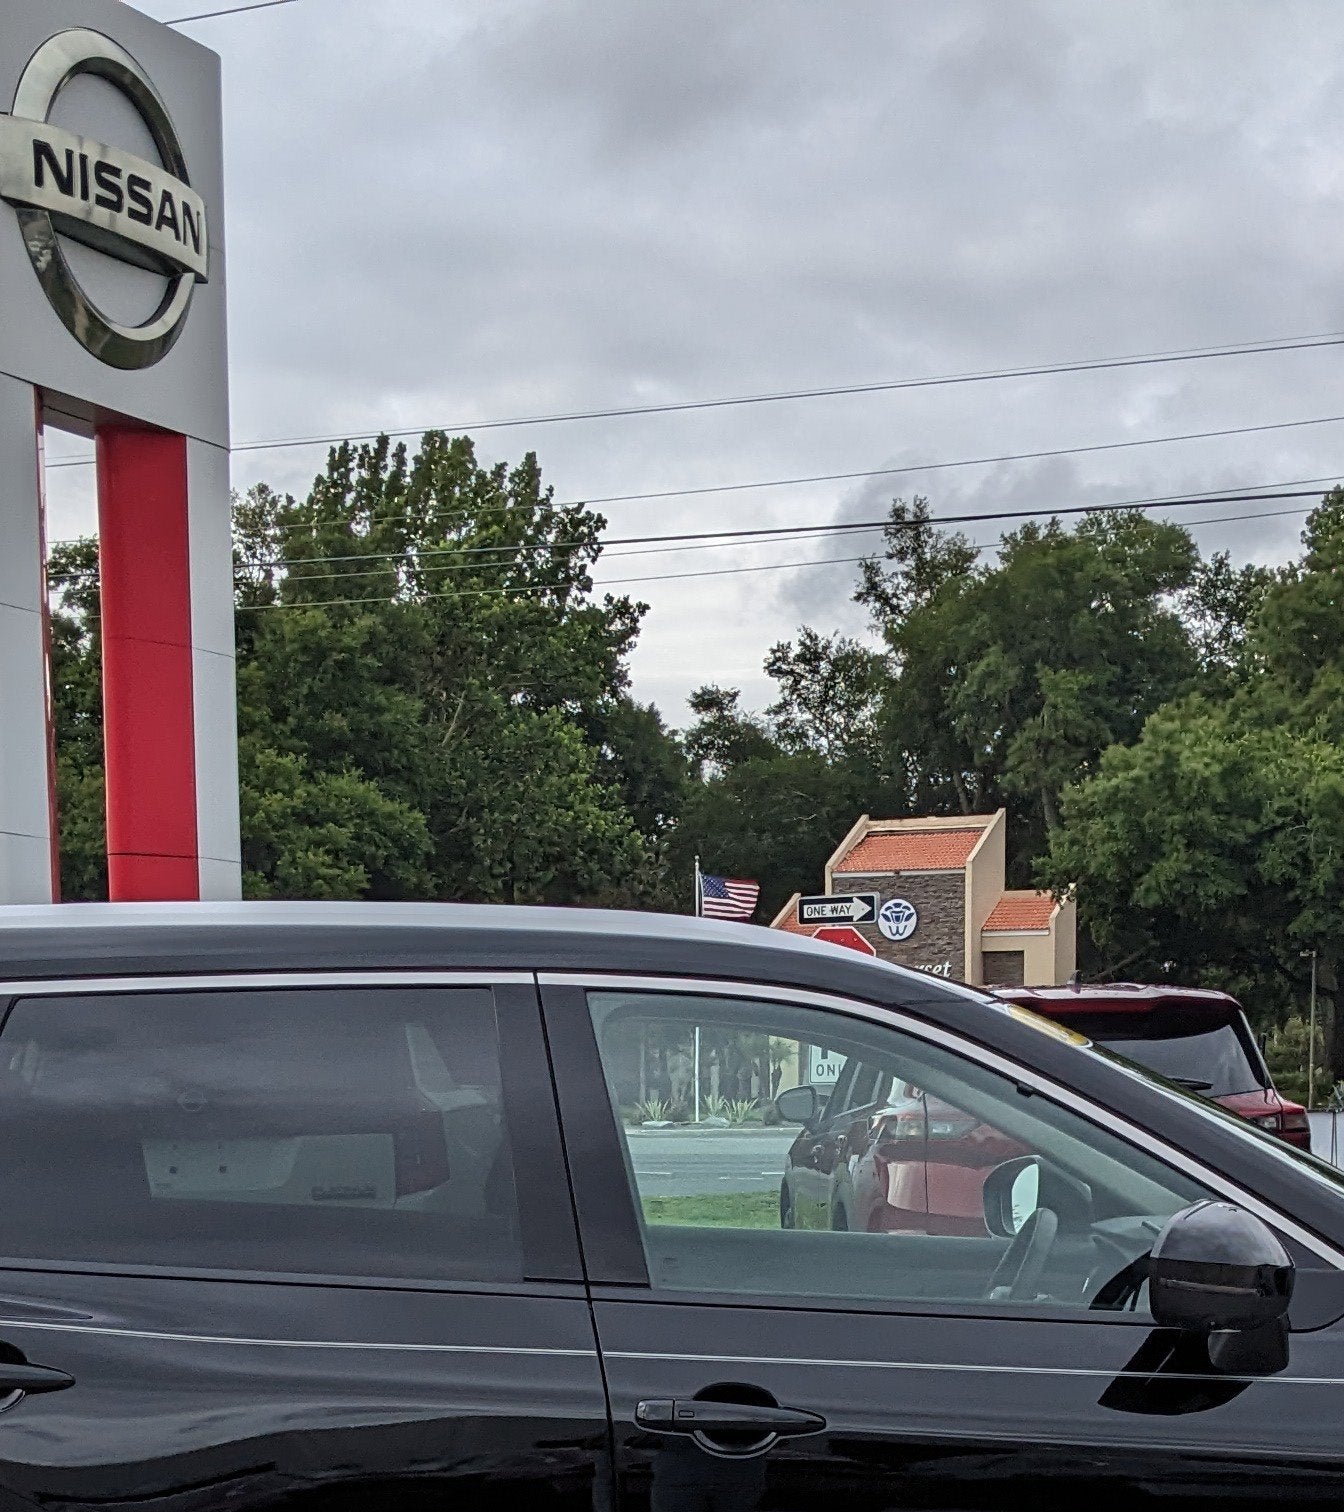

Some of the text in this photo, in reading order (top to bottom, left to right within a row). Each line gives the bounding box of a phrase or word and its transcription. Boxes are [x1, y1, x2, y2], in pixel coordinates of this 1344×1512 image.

[33, 139, 201, 254] NISSAN
[806, 905, 851, 916] ONE WAY
